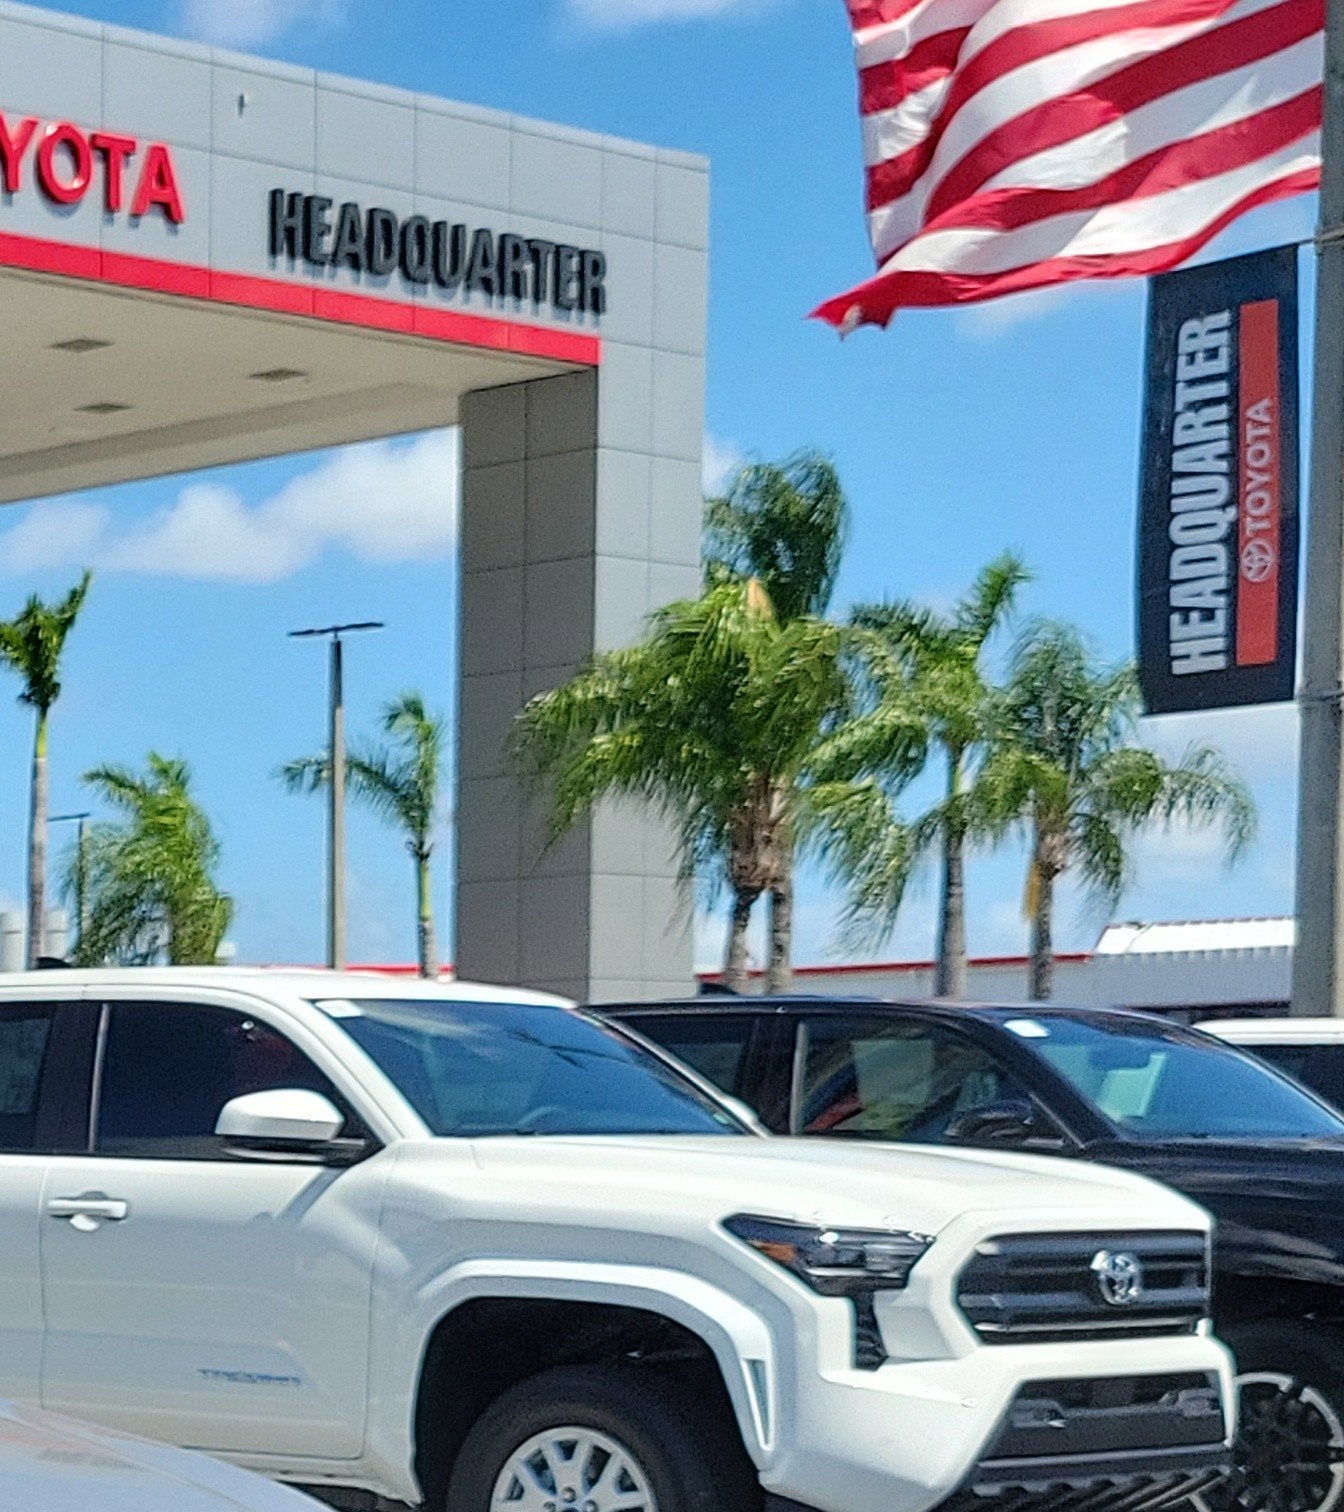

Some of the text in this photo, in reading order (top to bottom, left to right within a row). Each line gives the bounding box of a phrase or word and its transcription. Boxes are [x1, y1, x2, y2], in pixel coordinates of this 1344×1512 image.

[268, 188, 606, 315] HEADQUARTER
[1169, 308, 1236, 676] HEADQUARTER
[1245, 398, 1273, 534] TOYOTA
